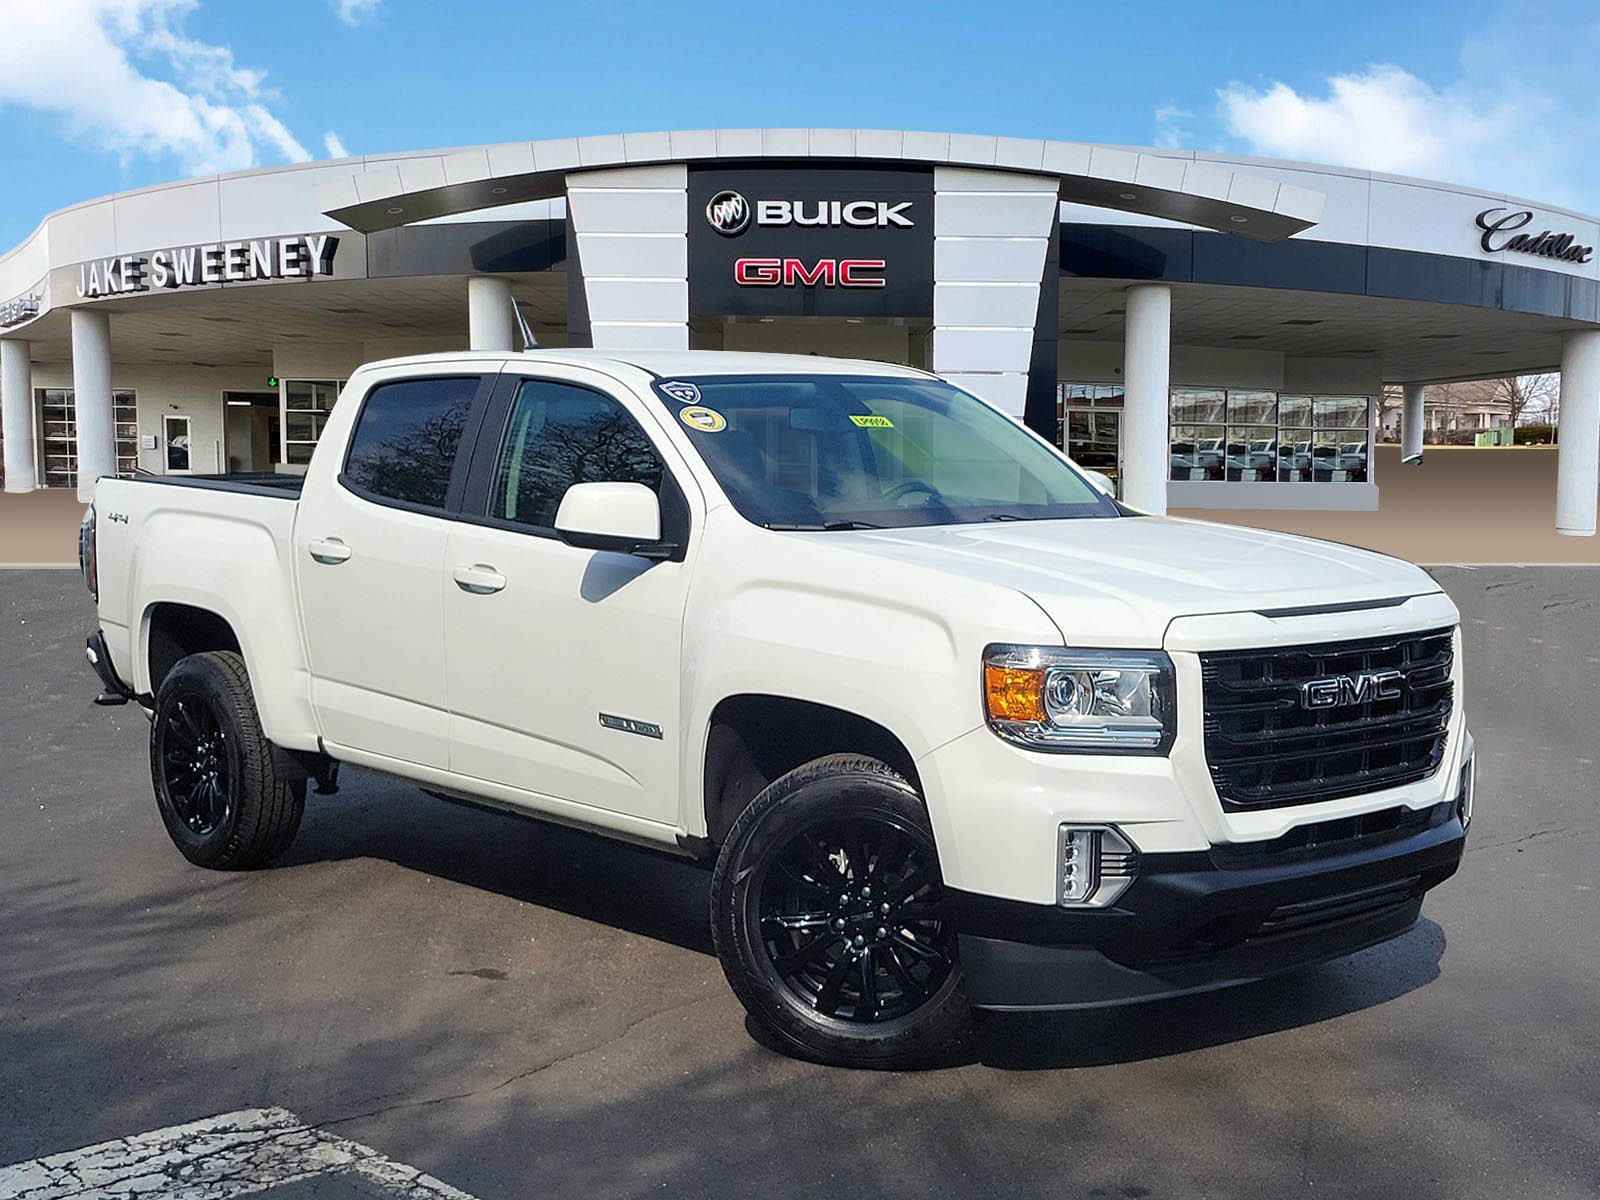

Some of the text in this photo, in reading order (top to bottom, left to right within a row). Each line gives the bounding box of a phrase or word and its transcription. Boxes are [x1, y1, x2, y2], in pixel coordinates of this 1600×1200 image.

[757, 200, 915, 226] BUICK
[1475, 207, 1593, 264] Cadillac
[76, 235, 334, 298] JAKE SWEENEY
[735, 258, 886, 287] GMC
[1301, 670, 1401, 711] GMC
